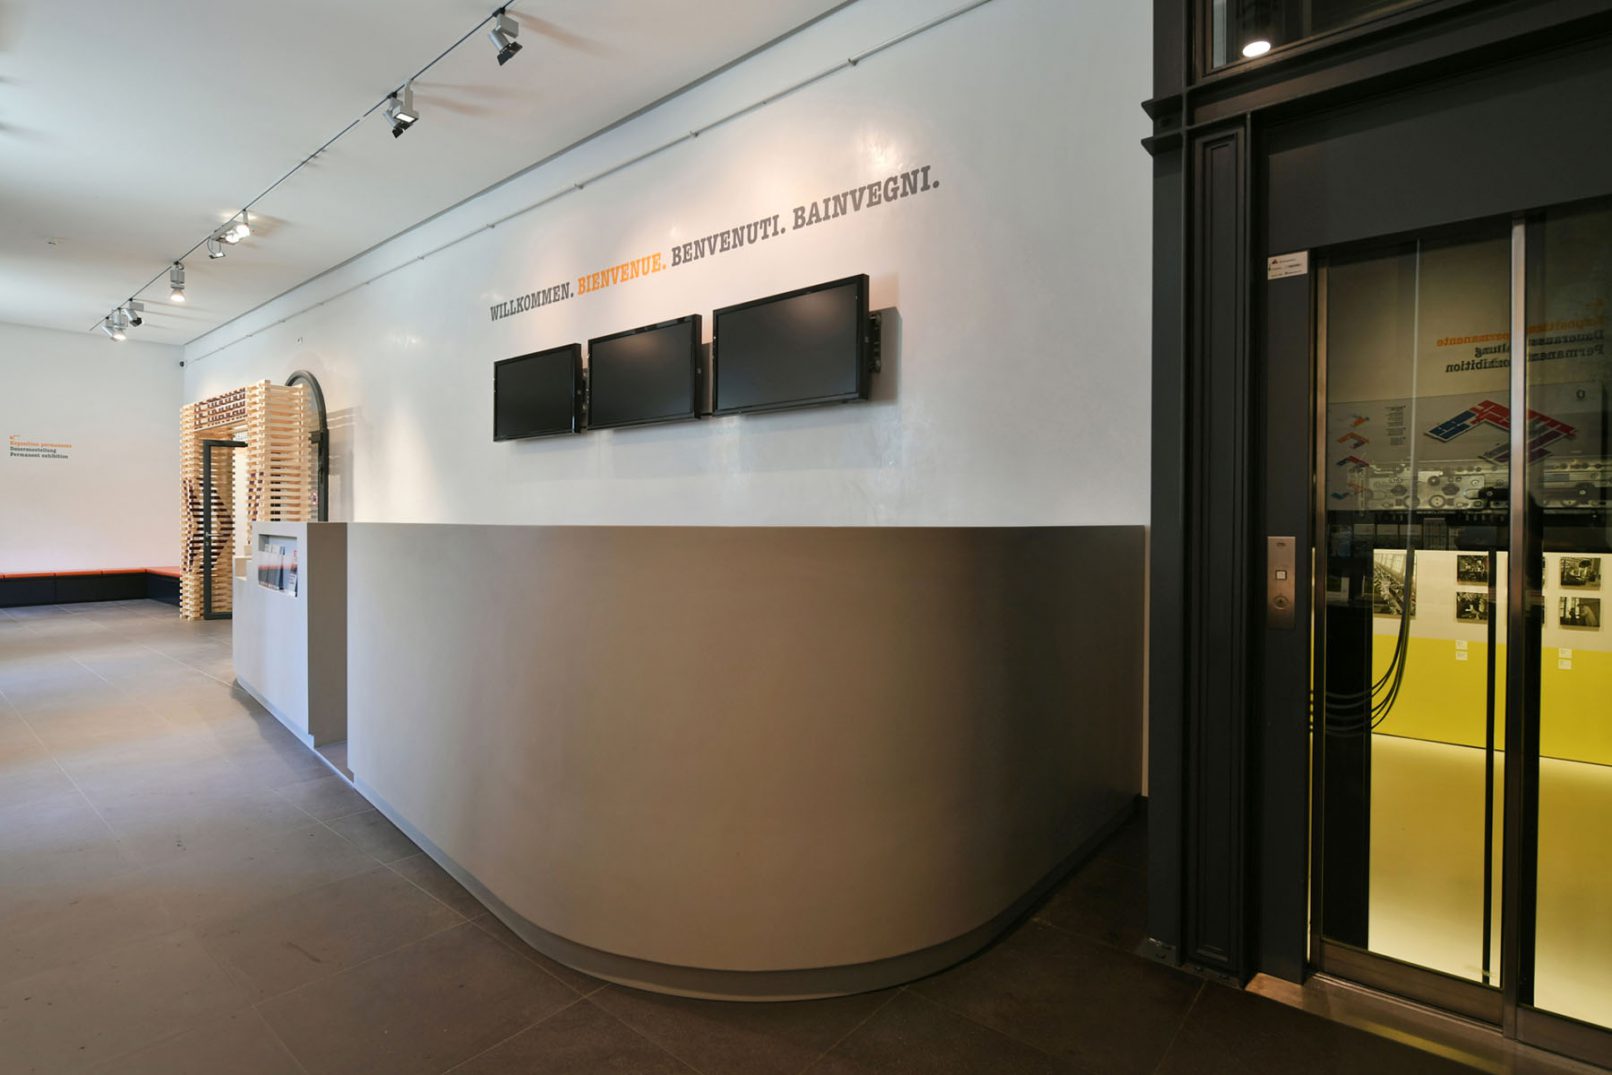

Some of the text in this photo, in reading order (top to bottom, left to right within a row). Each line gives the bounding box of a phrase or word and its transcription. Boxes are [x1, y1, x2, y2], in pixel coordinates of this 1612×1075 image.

[490, 165, 940, 321] WILLKOMMEN. BIENVENUE. BENVENUTI. BAINVEGNI.
